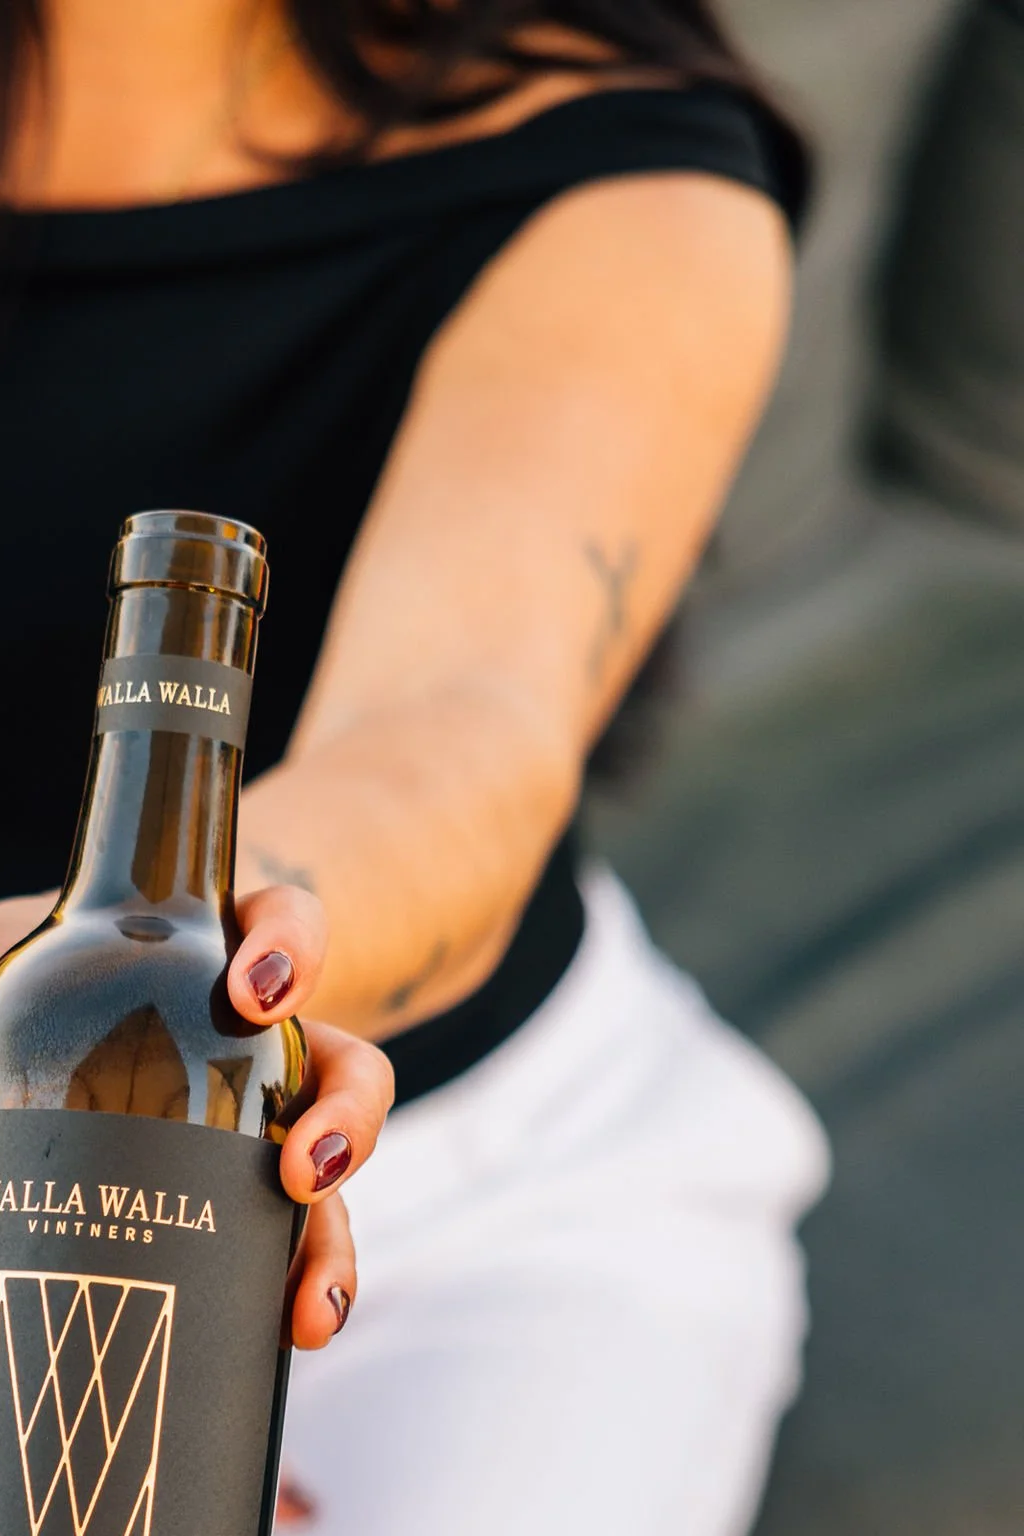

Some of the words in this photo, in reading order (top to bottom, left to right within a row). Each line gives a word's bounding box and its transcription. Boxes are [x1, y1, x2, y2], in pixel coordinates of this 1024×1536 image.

[158, 682, 231, 715] WALLA
[98, 1184, 217, 1233] WALLA
[28, 1219, 153, 1243] VINTNERS
